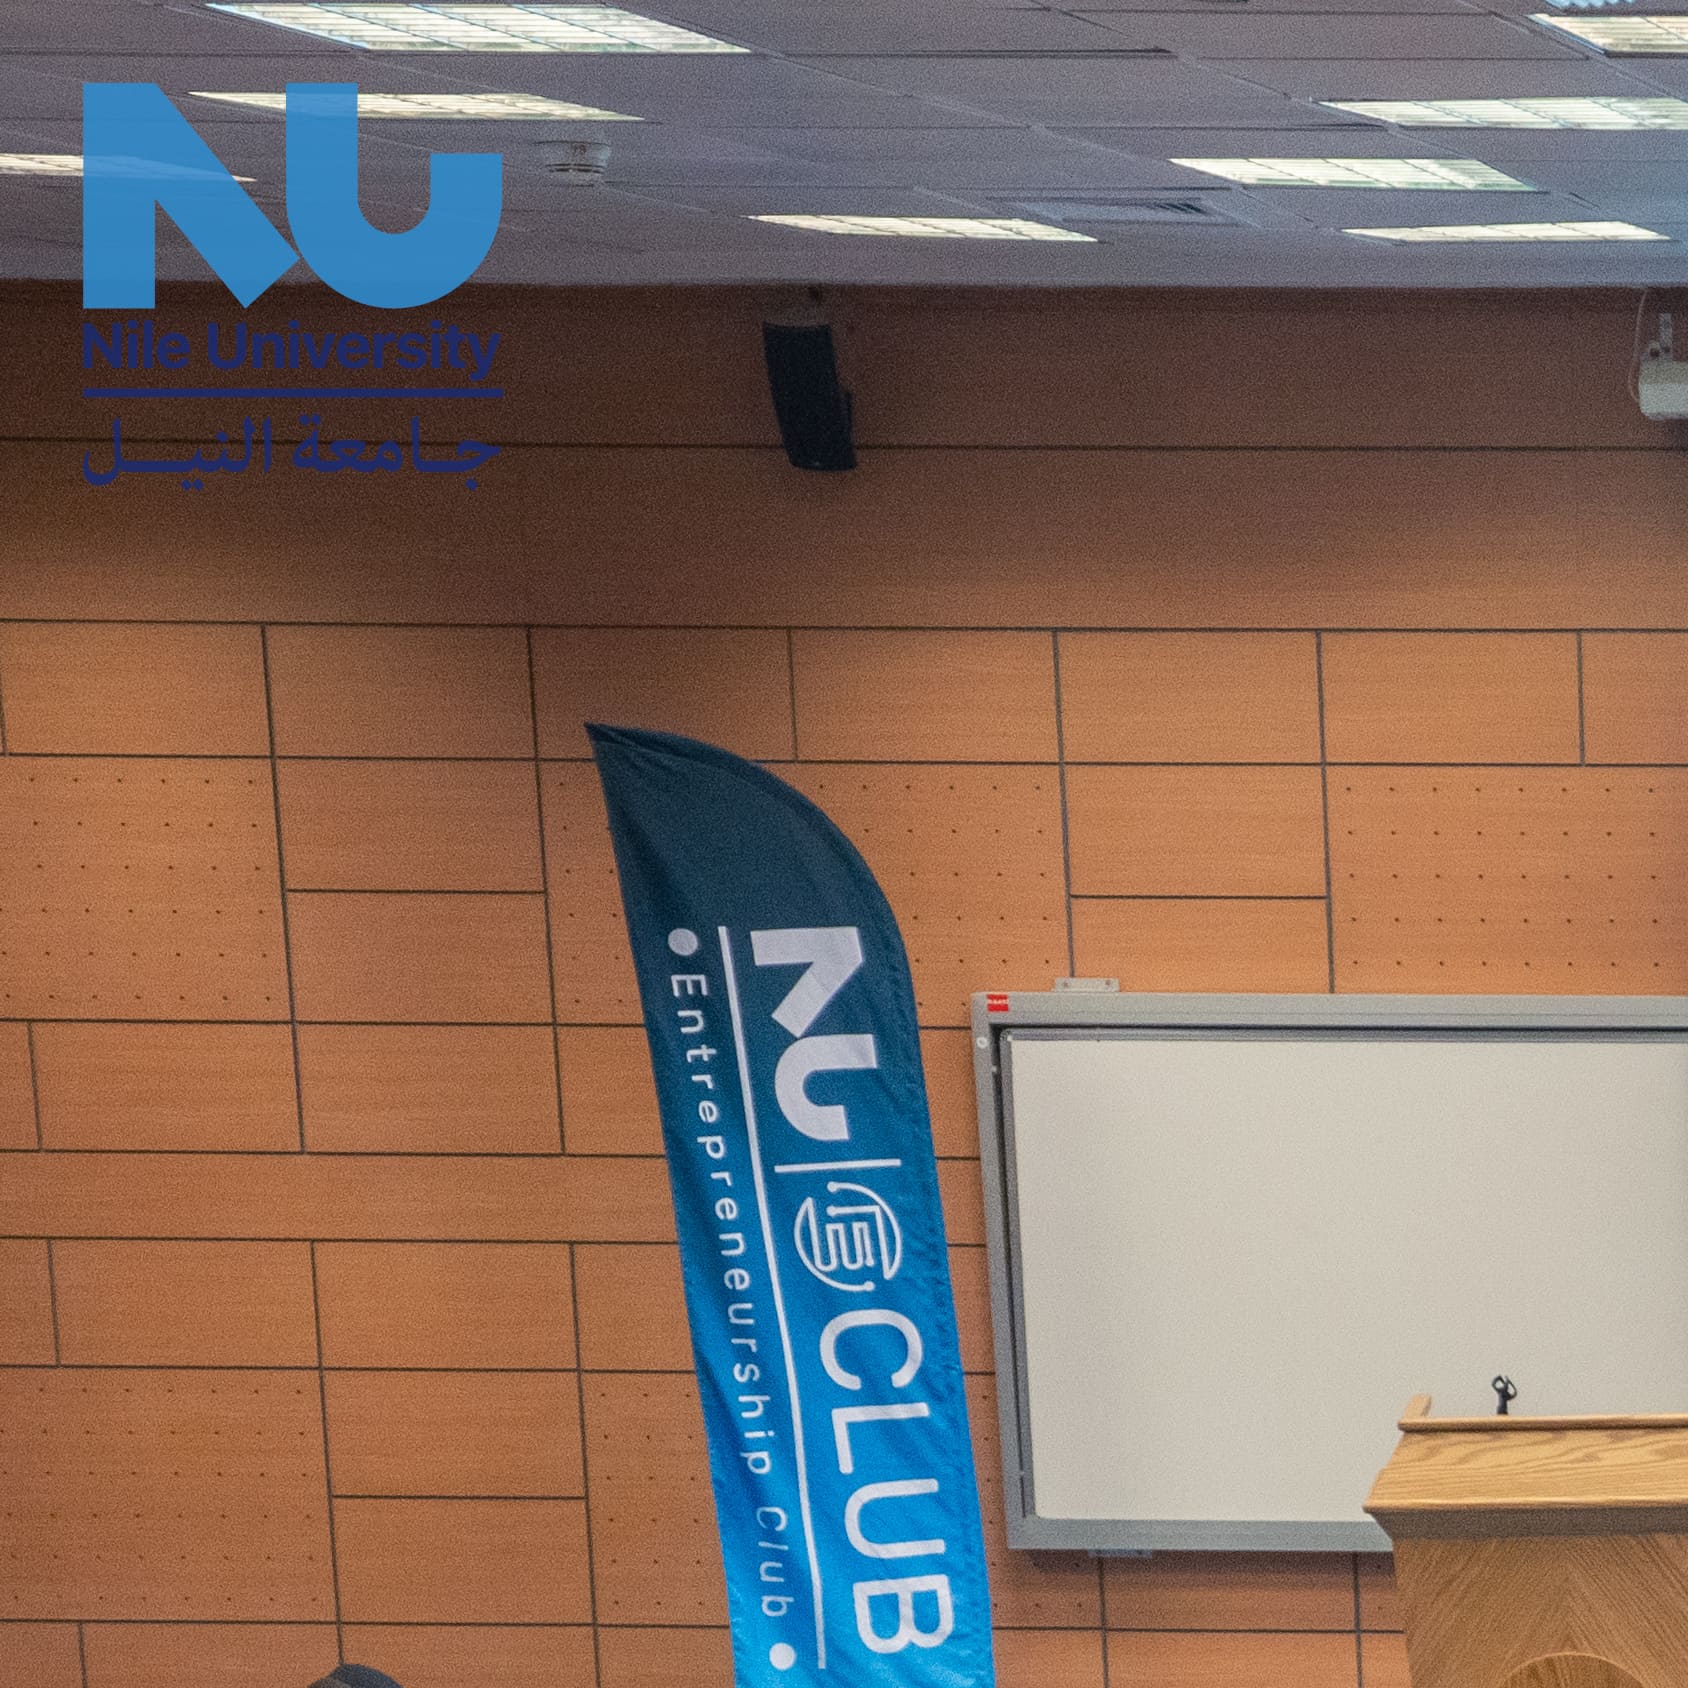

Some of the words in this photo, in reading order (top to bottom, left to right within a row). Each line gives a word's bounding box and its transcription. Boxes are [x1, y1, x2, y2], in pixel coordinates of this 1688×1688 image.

[670, 973, 772, 1476] Entrepreneurship
[758, 1505, 796, 1618] Club
[749, 925, 880, 1143] NU
[818, 1308, 952, 1654] CLUB
